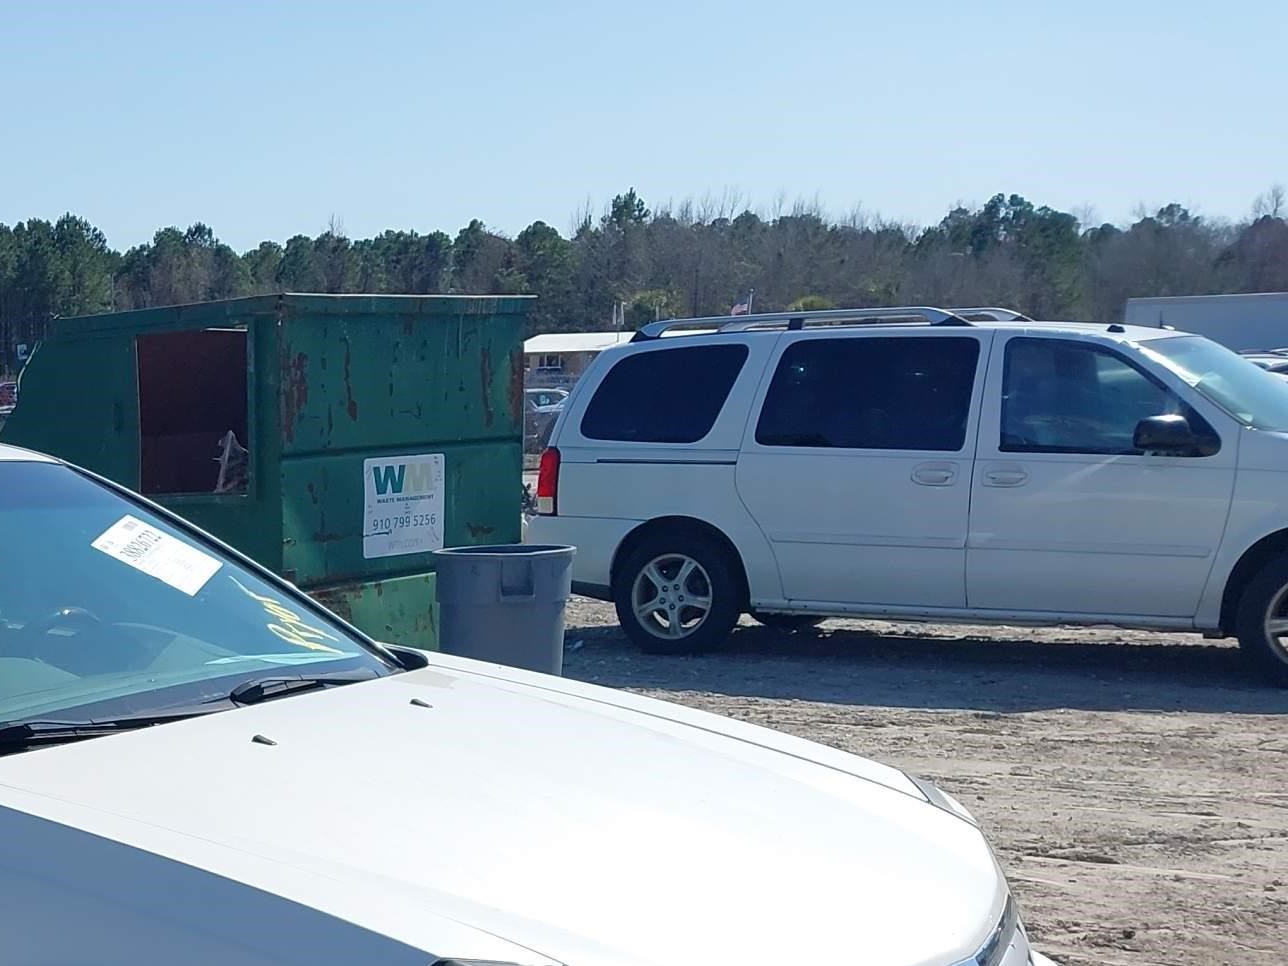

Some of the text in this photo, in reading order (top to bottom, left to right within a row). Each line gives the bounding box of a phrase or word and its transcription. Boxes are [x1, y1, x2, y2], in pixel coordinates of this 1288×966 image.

[372, 513, 437, 531] 910 799 5256
